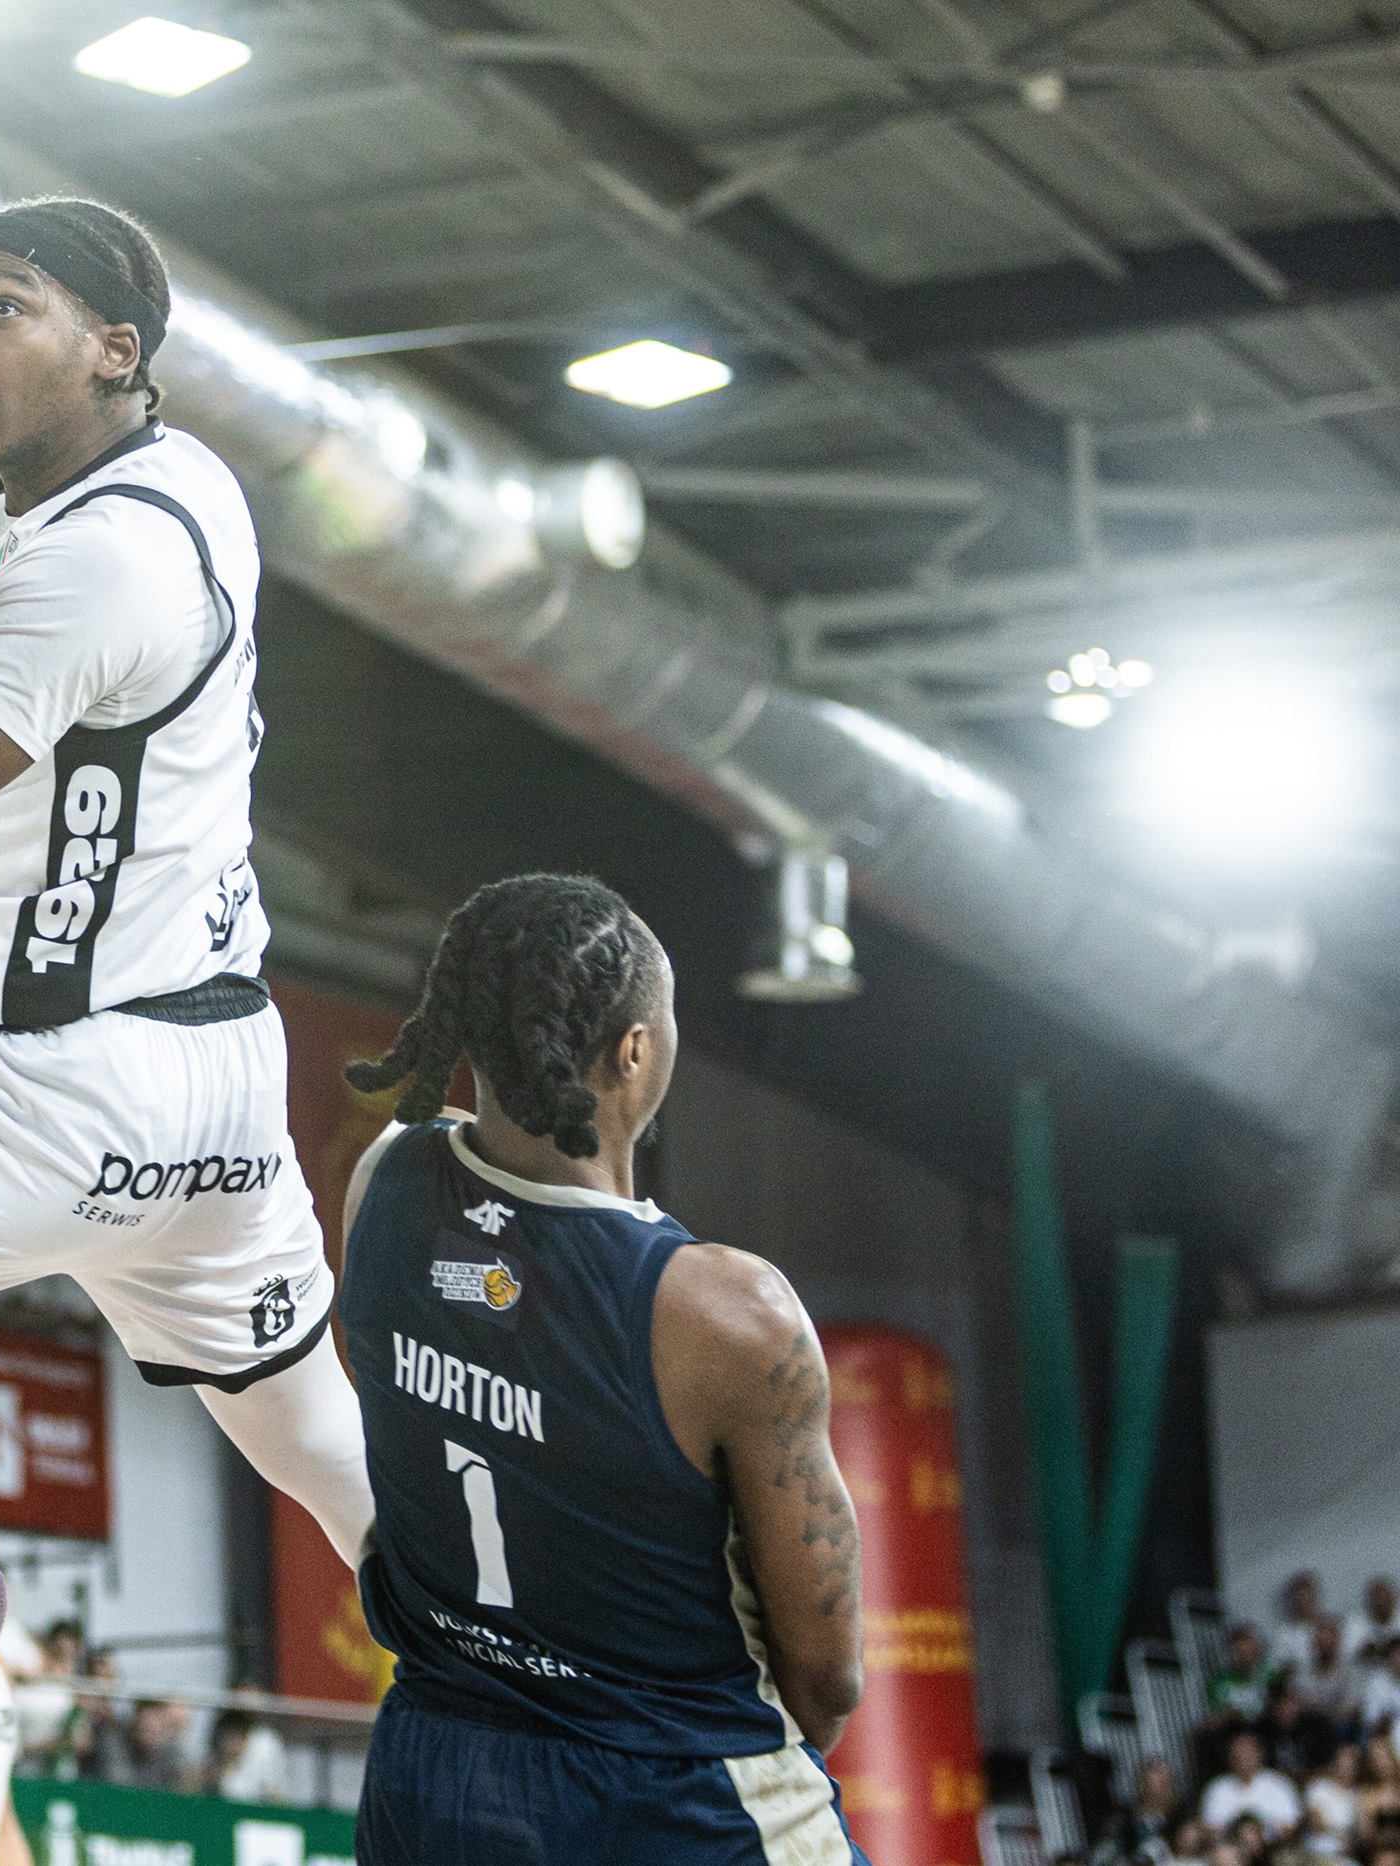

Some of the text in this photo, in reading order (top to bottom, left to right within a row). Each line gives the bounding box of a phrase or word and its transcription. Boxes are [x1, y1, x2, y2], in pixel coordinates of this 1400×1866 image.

[25, 764, 122, 974] 1929
[72, 1200, 146, 1227] SERWIS
[393, 1331, 545, 1443] HORTON
[444, 1438, 514, 1608] 1
